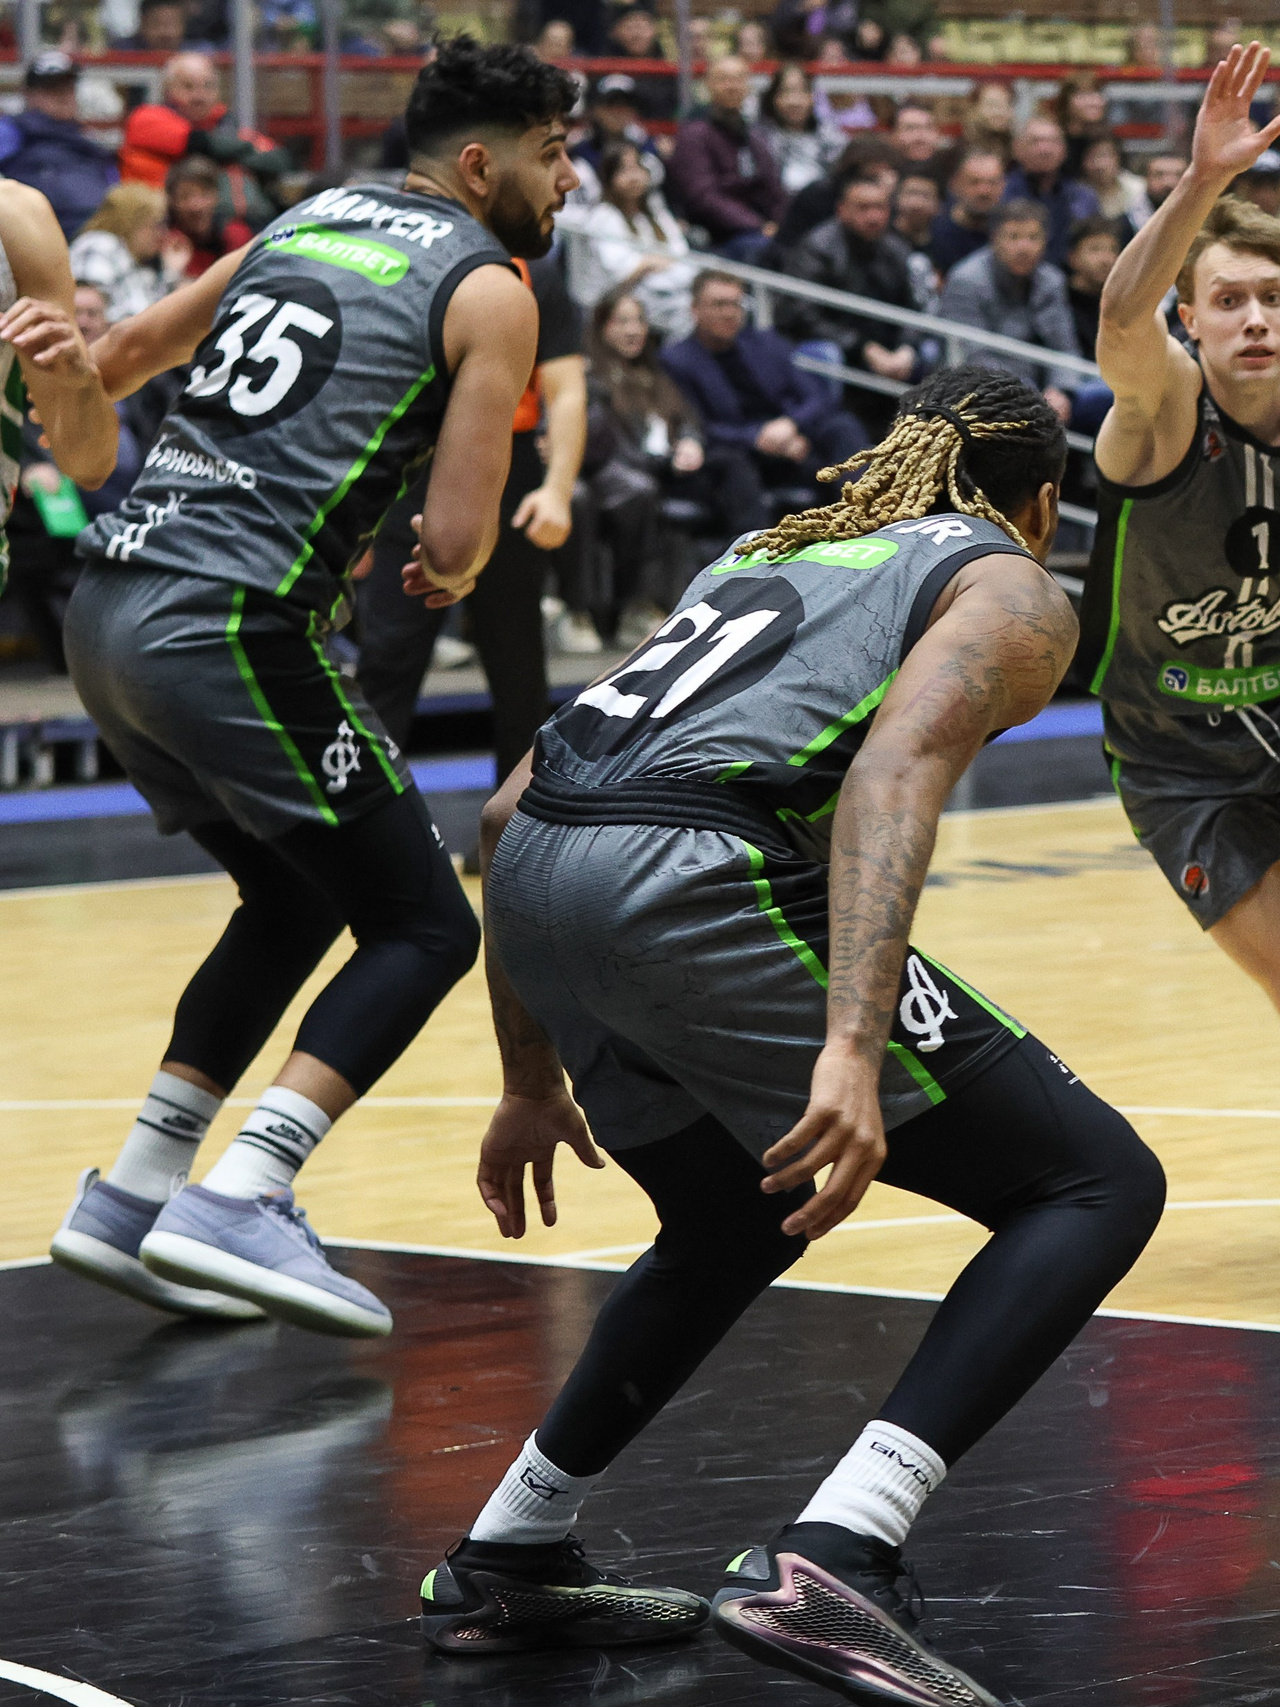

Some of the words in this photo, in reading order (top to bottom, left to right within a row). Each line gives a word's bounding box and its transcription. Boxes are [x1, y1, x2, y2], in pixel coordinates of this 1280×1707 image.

[184, 293, 335, 417] 35
[1251, 521, 1270, 570] 1
[572, 600, 782, 719] 21
